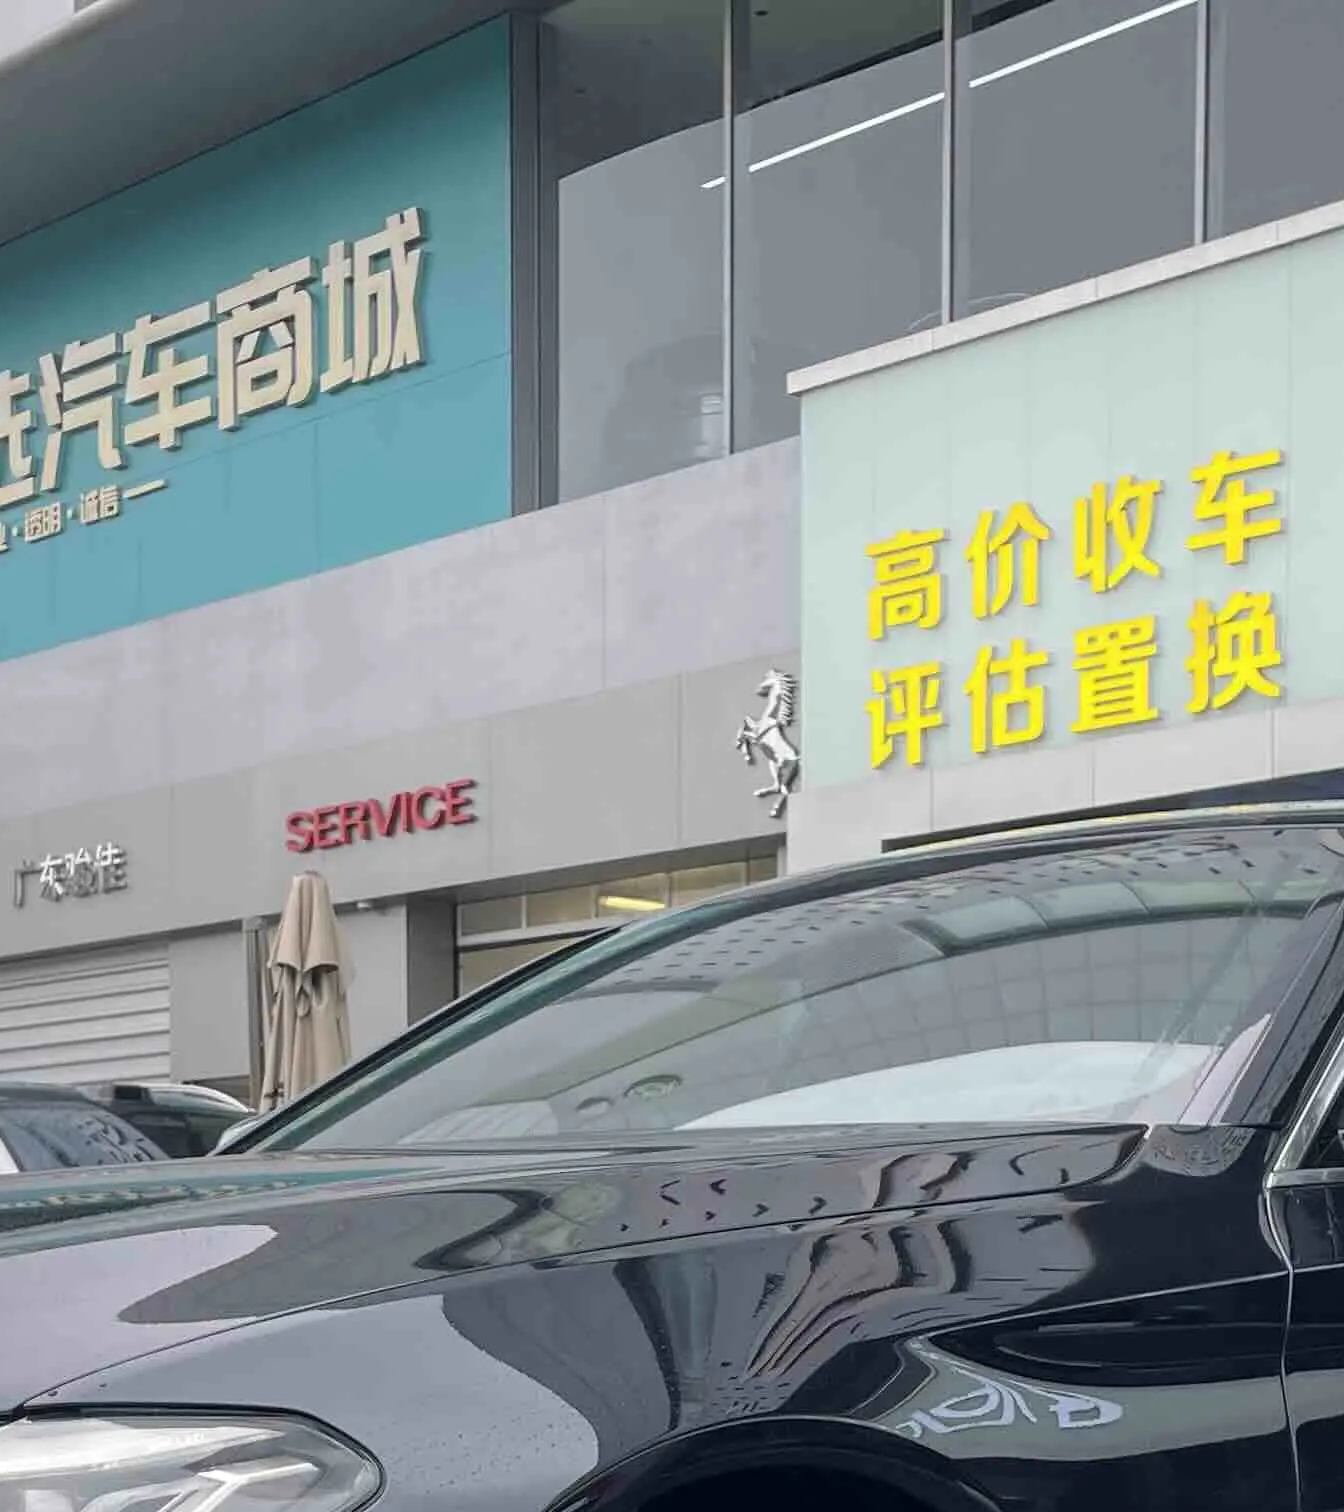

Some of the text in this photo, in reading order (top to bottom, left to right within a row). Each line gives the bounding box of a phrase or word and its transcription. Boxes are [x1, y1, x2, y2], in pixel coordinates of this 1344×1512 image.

[864, 448, 1283, 641] 高价收车
[864, 590, 1283, 769] 评估置换
[285, 776, 478, 854] SERVICE
